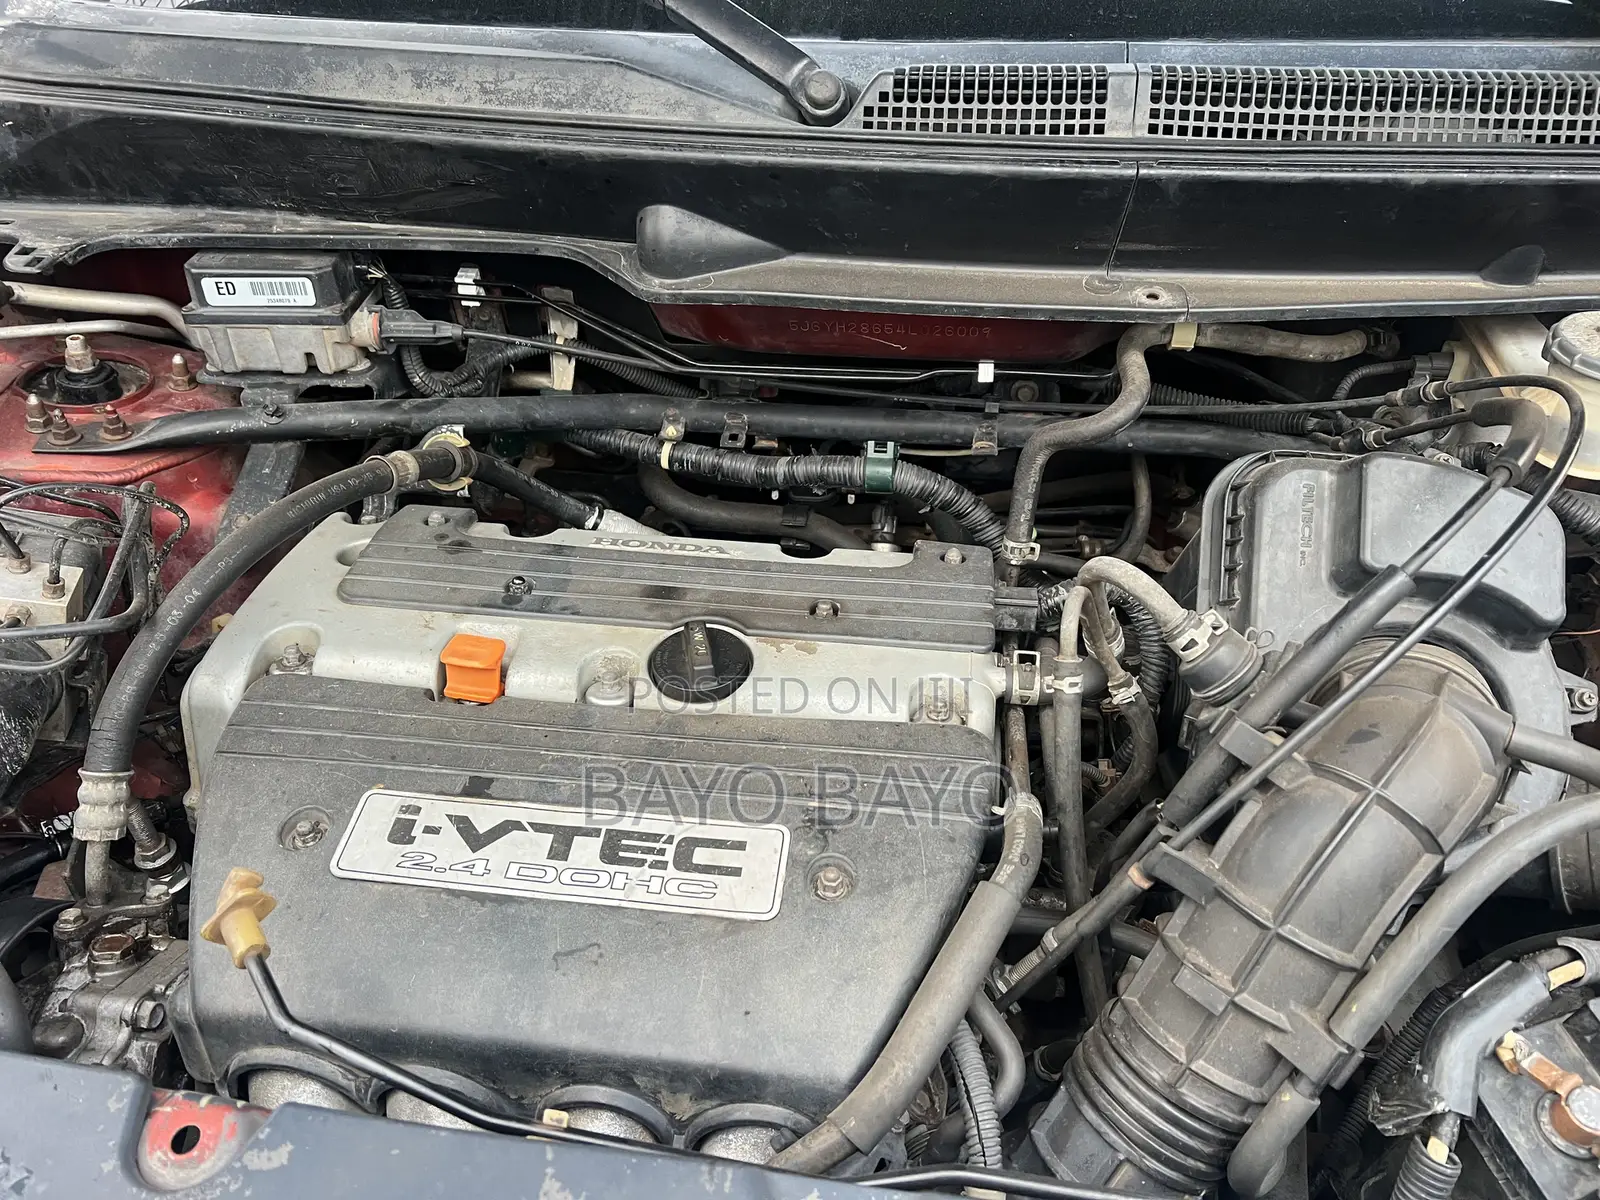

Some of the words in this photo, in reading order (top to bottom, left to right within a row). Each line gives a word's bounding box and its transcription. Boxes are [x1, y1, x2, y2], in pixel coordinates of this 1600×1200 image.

[214, 281, 236, 296] ED
[1300, 483, 1316, 548] FILTECH
[591, 537, 731, 555] HONDA
[694, 643, 707, 657] 20
[386, 803, 747, 878] i-VTEC
[395, 850, 491, 877] 2.4
[504, 860, 718, 900] DOHC
